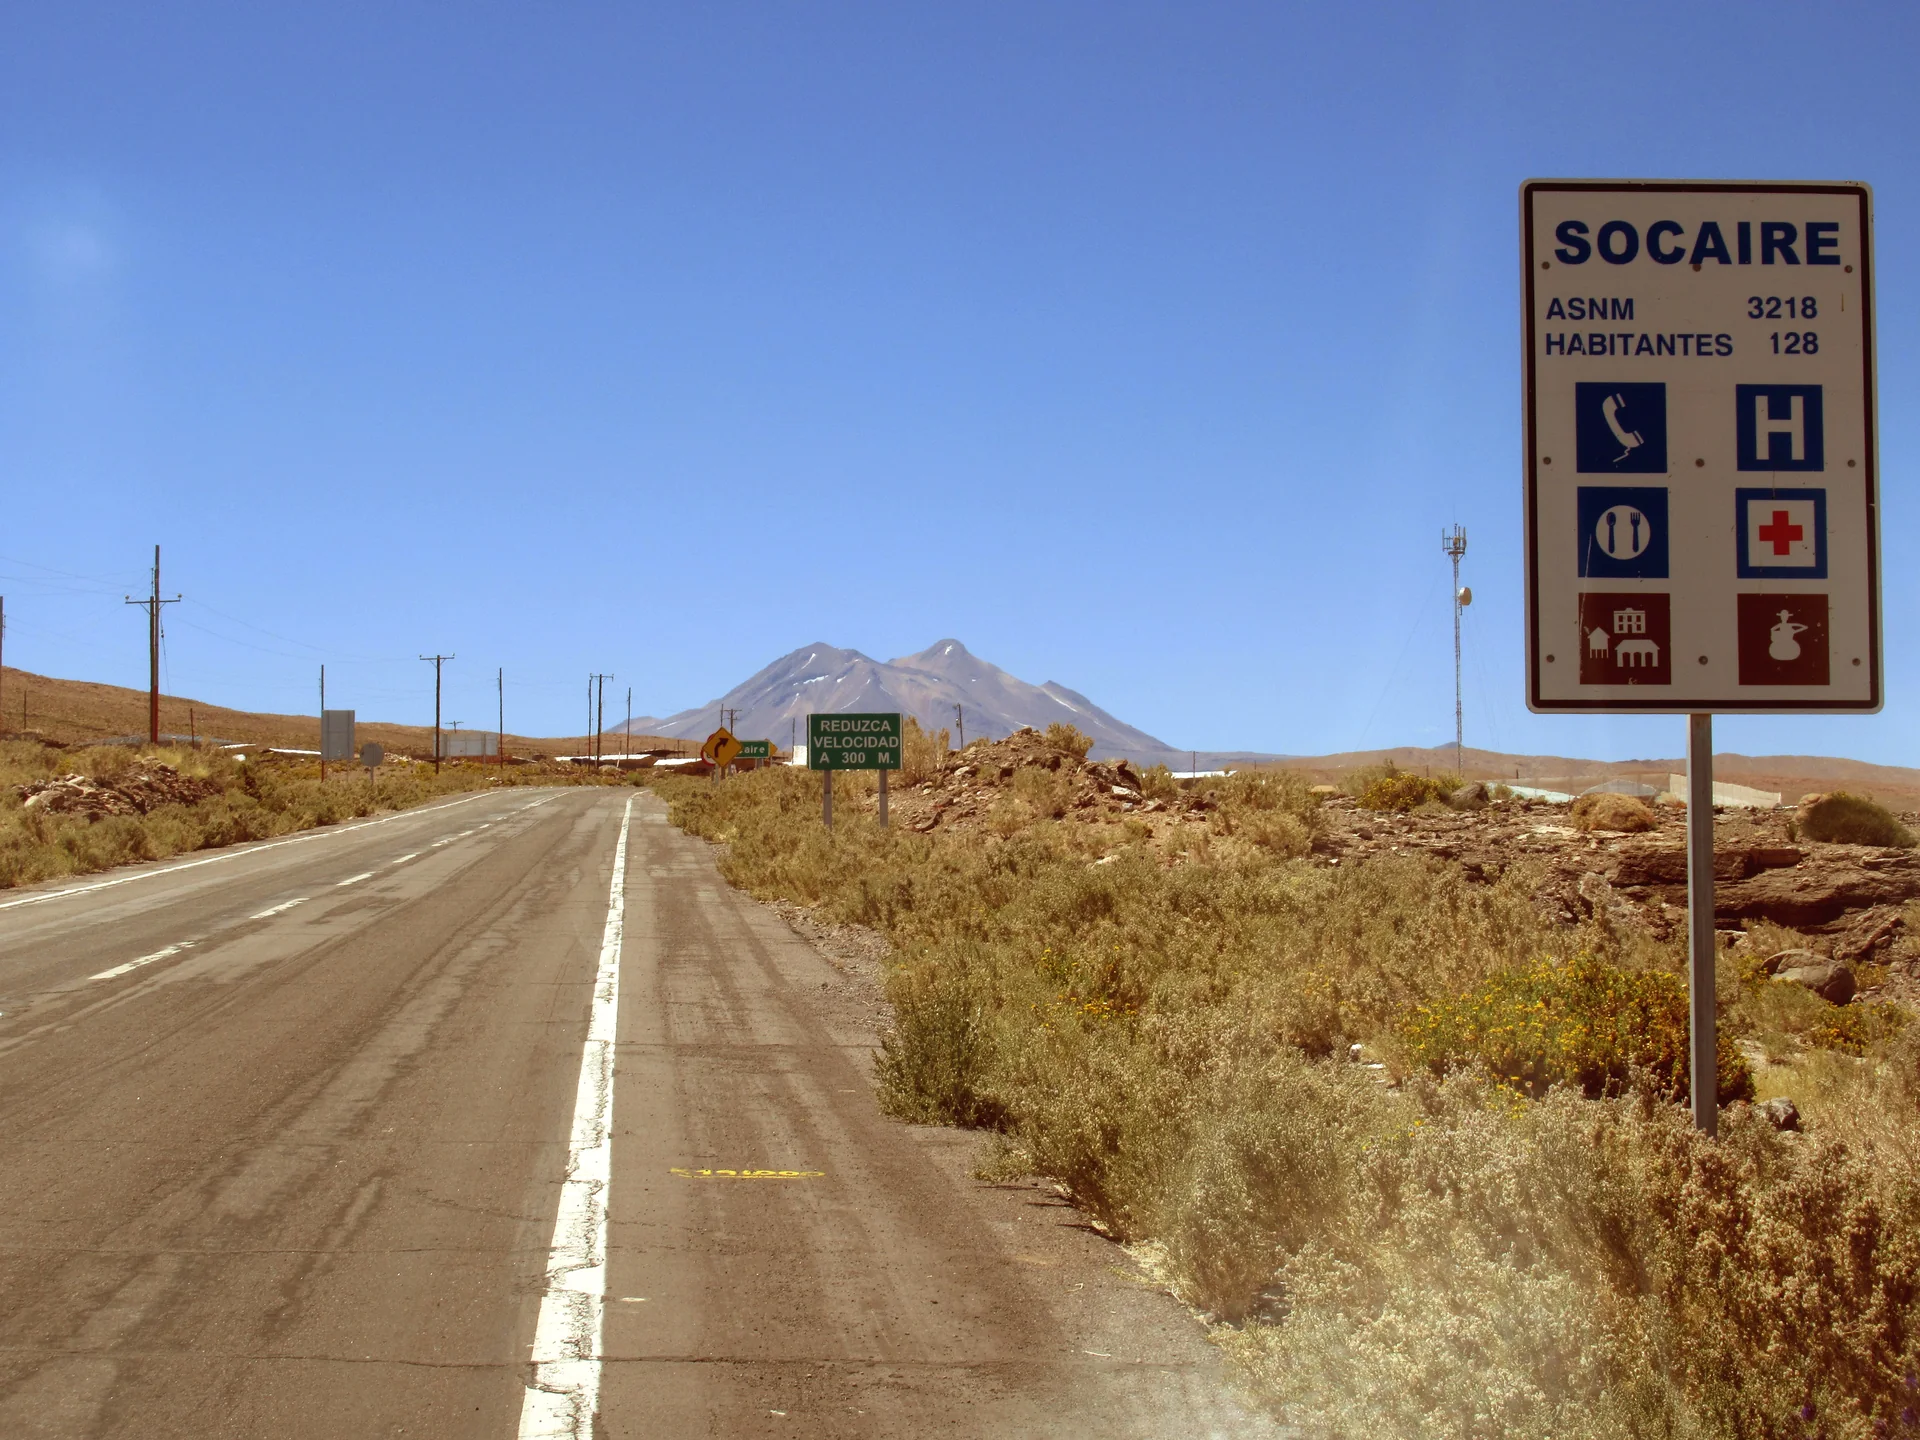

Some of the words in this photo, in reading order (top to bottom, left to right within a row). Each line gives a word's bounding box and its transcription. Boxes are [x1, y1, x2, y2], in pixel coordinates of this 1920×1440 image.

[1553, 219, 1842, 266] SOCAIRE
[1545, 297, 1635, 321] ASNM
[1747, 295, 1819, 320] 3218
[1544, 332, 1734, 357] HABITANTES
[1769, 331, 1820, 355] 128
[1754, 395, 1805, 461] H
[820, 719, 892, 732] REDUZCA
[813, 735, 900, 749] VELOCIDAD
[819, 751, 830, 764] A
[841, 751, 866, 764] 300
[877, 751, 894, 764] M.
